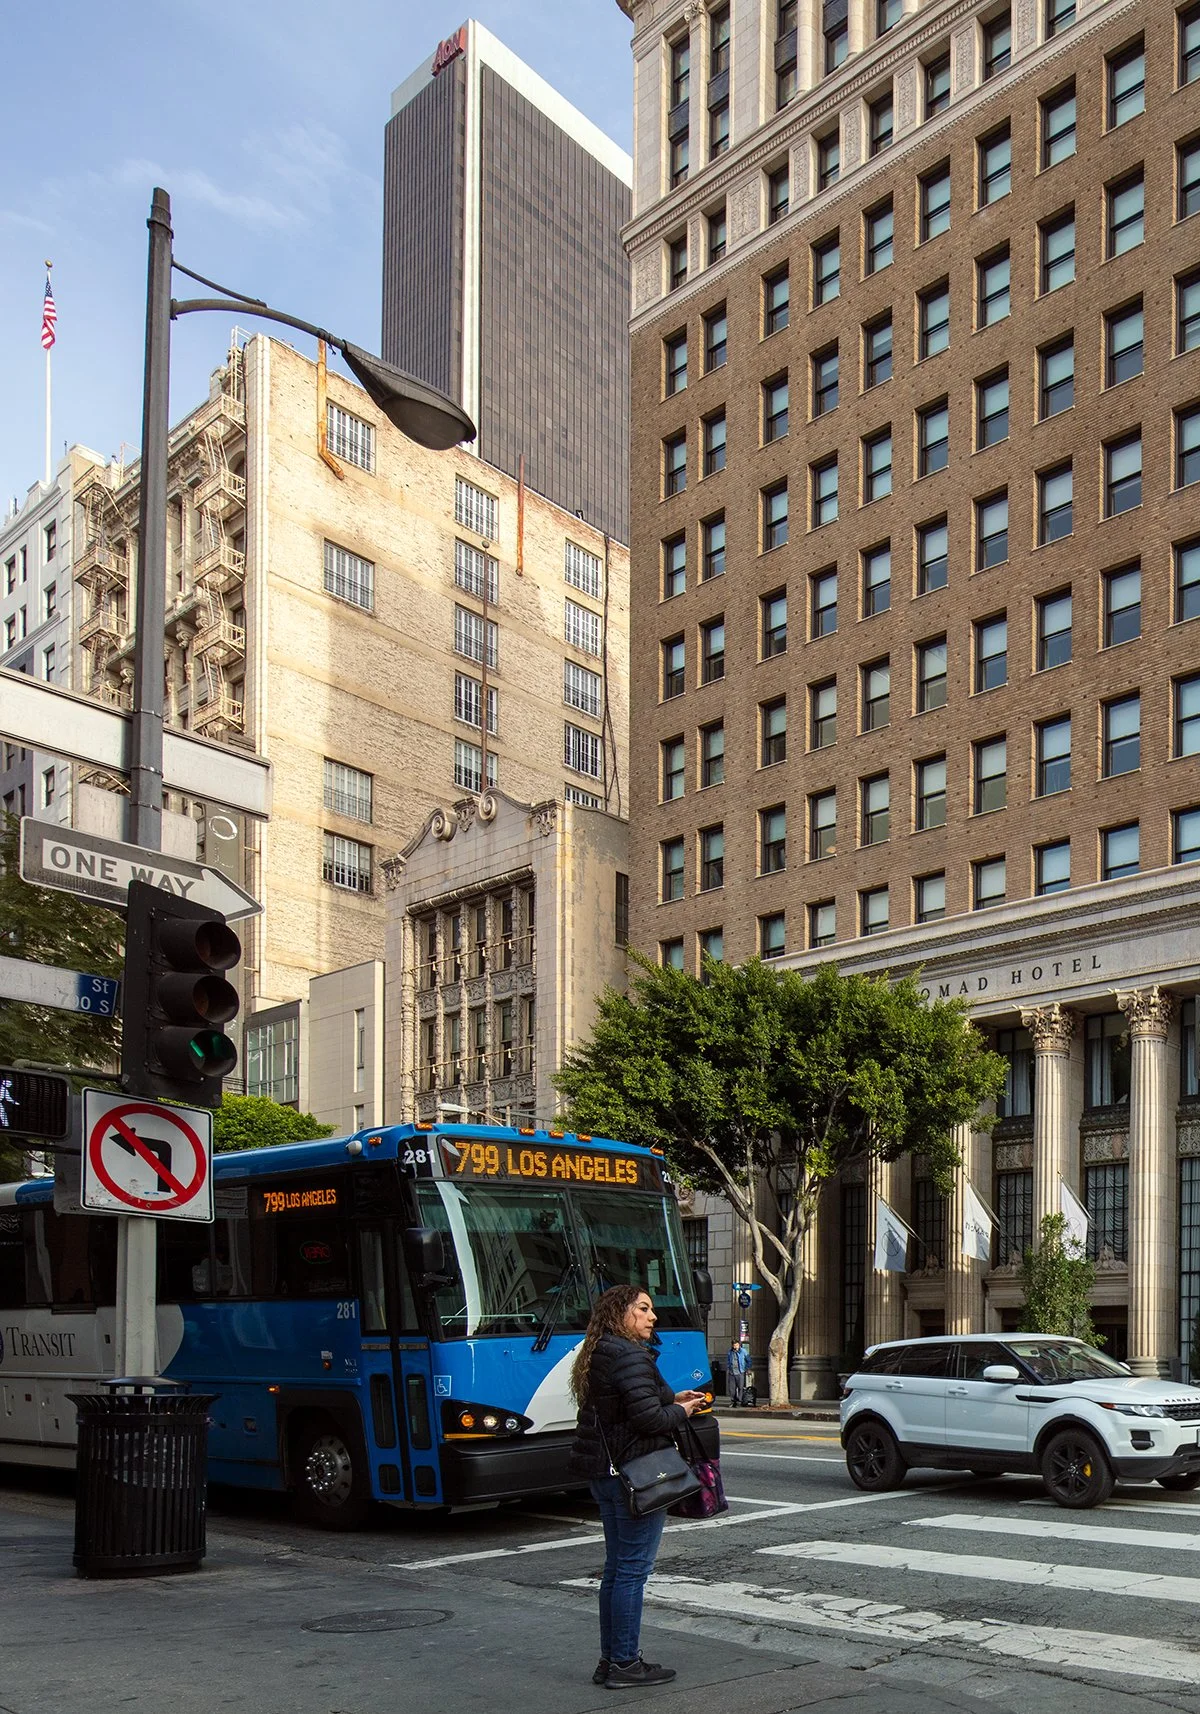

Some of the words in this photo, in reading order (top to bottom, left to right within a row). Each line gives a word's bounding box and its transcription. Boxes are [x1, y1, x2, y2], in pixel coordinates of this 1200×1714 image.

[50, 846, 118, 883] ONE
[130, 865, 196, 899] WAY
[92, 978, 110, 994] St
[918, 977, 988, 1001] OMAD
[1011, 955, 1102, 985] HOTEL
[99, 1000, 110, 1013] S
[404, 1149, 436, 1165] 281
[454, 1141, 499, 1174] 799
[507, 1148, 548, 1177] LOS
[551, 1153, 638, 1184] ANGELES
[263, 1192, 286, 1213] 799
[286, 1194, 301, 1209] LOS
[301, 1188, 337, 1208] ANGELES
[336, 1301, 357, 1319] 281
